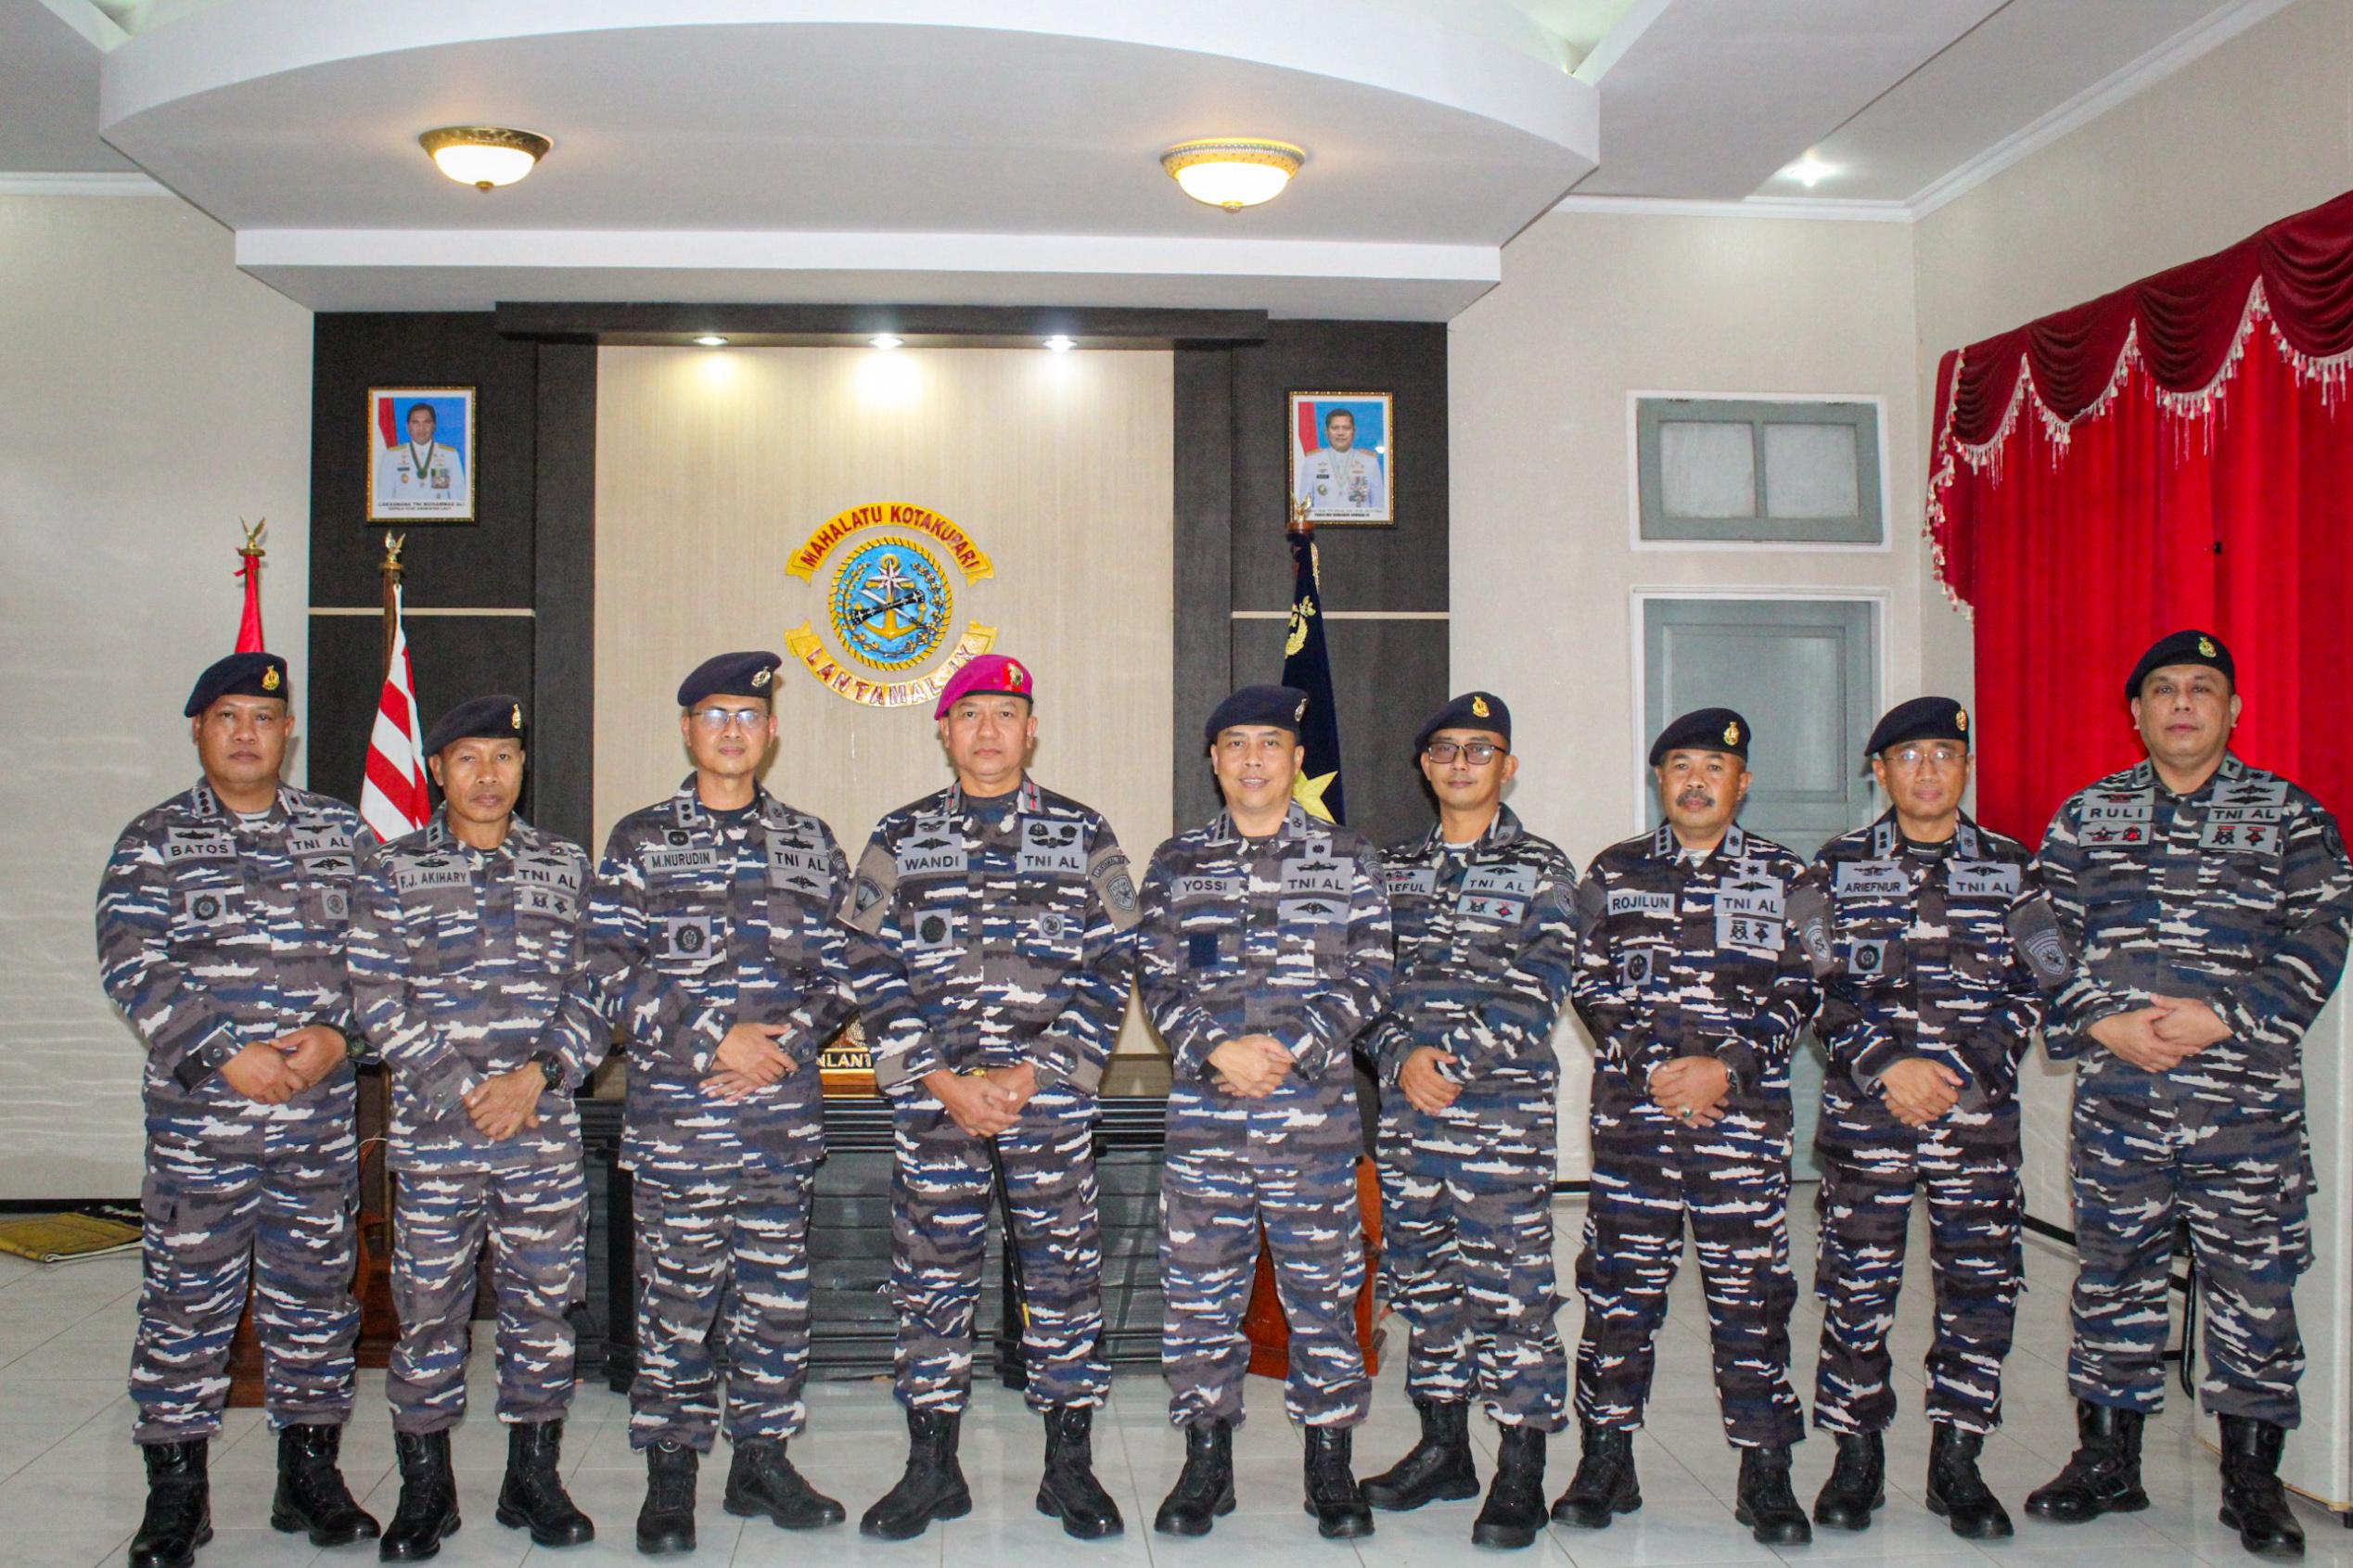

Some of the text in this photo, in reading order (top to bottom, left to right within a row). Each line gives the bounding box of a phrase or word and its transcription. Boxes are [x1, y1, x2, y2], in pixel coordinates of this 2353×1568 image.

[800, 505, 980, 568] MAHALATU KOTAKUPARI
[806, 644, 977, 705] LANTAMAL IX
[2090, 808, 2143, 819] RULI
[2214, 808, 2275, 820] TNI AL
[292, 836, 350, 850] TNI AL
[171, 844, 228, 857] BATOS
[651, 851, 710, 868] M.NURUDIN
[774, 851, 826, 872] TNI AL
[905, 855, 959, 870] WANDI
[1024, 855, 1052, 867] TNI
[1058, 857, 1080, 869] AL
[400, 872, 467, 890] F.J. AKIHARY
[518, 869, 577, 890] TNI AL
[1183, 880, 1227, 891] YOSSI
[1287, 878, 1344, 890] TNI AL
[1469, 879, 1525, 892] TNI AL
[1844, 881, 1901, 893] ARIEFNUR
[1956, 881, 2014, 895] TNI AL
[1612, 897, 1670, 911] ROJILUN
[1723, 898, 1778, 913] TNI AL
